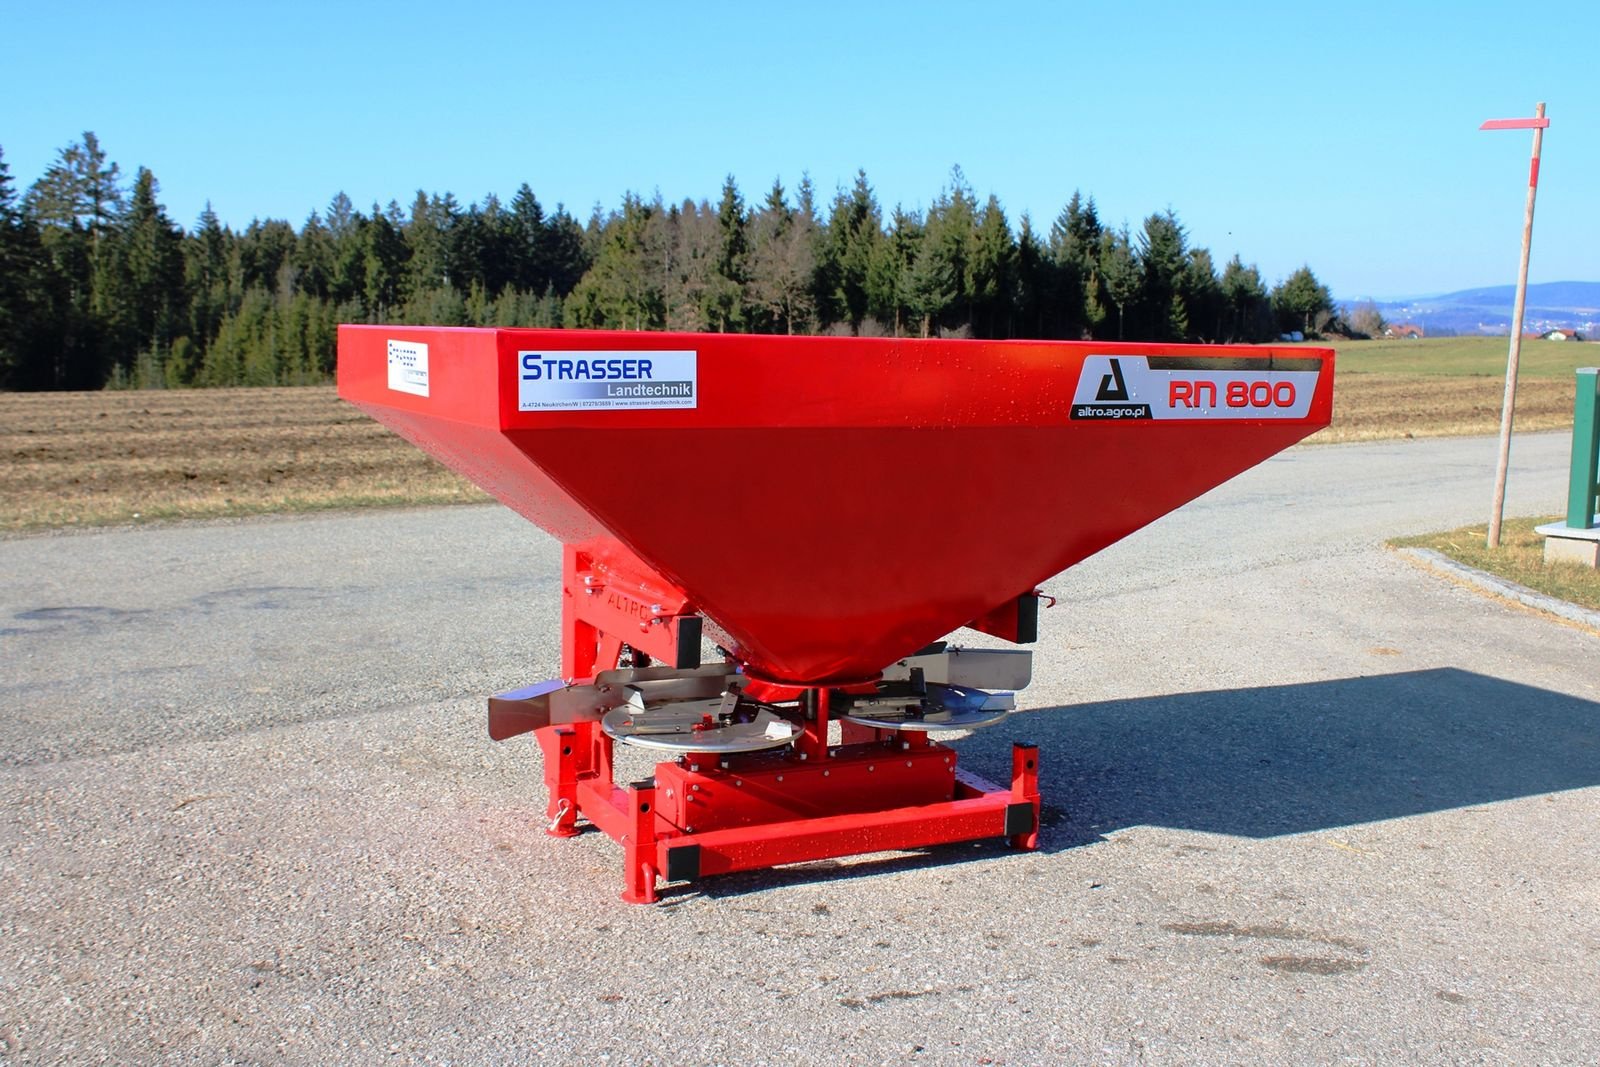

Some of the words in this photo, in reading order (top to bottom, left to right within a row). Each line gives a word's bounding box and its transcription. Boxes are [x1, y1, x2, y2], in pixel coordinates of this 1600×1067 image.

[522, 354, 653, 380] STRASSER
[607, 383, 691, 397] Landtechnik
[1225, 381, 1296, 409] 800
[1078, 406, 1145, 418] altro.agro.pl
